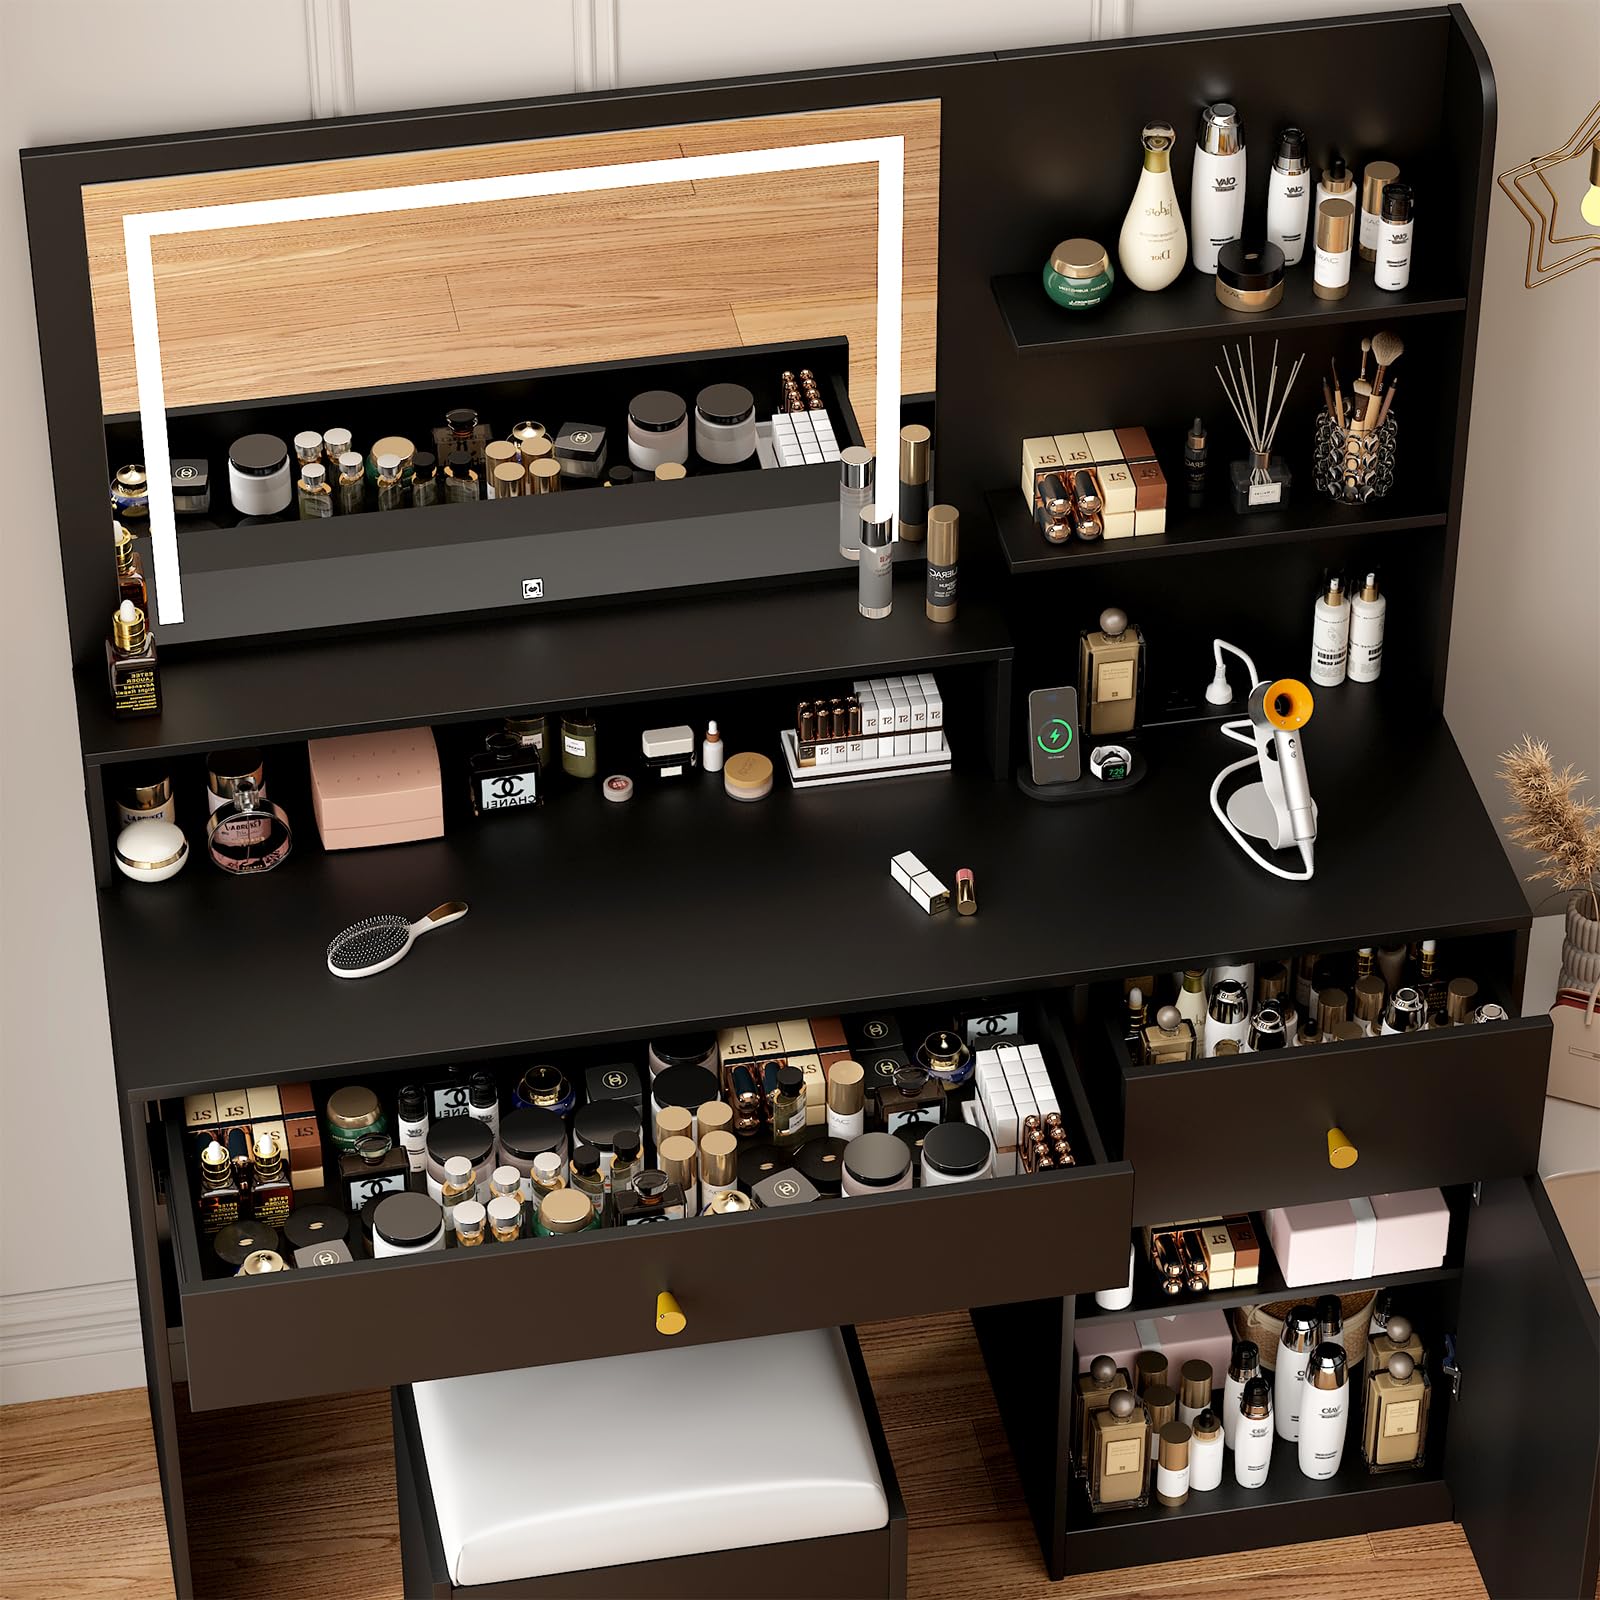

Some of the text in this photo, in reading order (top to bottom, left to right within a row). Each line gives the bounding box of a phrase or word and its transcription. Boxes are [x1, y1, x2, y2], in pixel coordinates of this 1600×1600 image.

[1039, 454, 1057, 464] ST
[1070, 451, 1087, 461] ST
[1108, 472, 1127, 482] ST
[729, 1044, 747, 1055] ST
[760, 1040, 779, 1051] ST
[194, 1110, 212, 1121] ST
[225, 1106, 244, 1117] ST
[1212, 1234, 1227, 1244] ST
